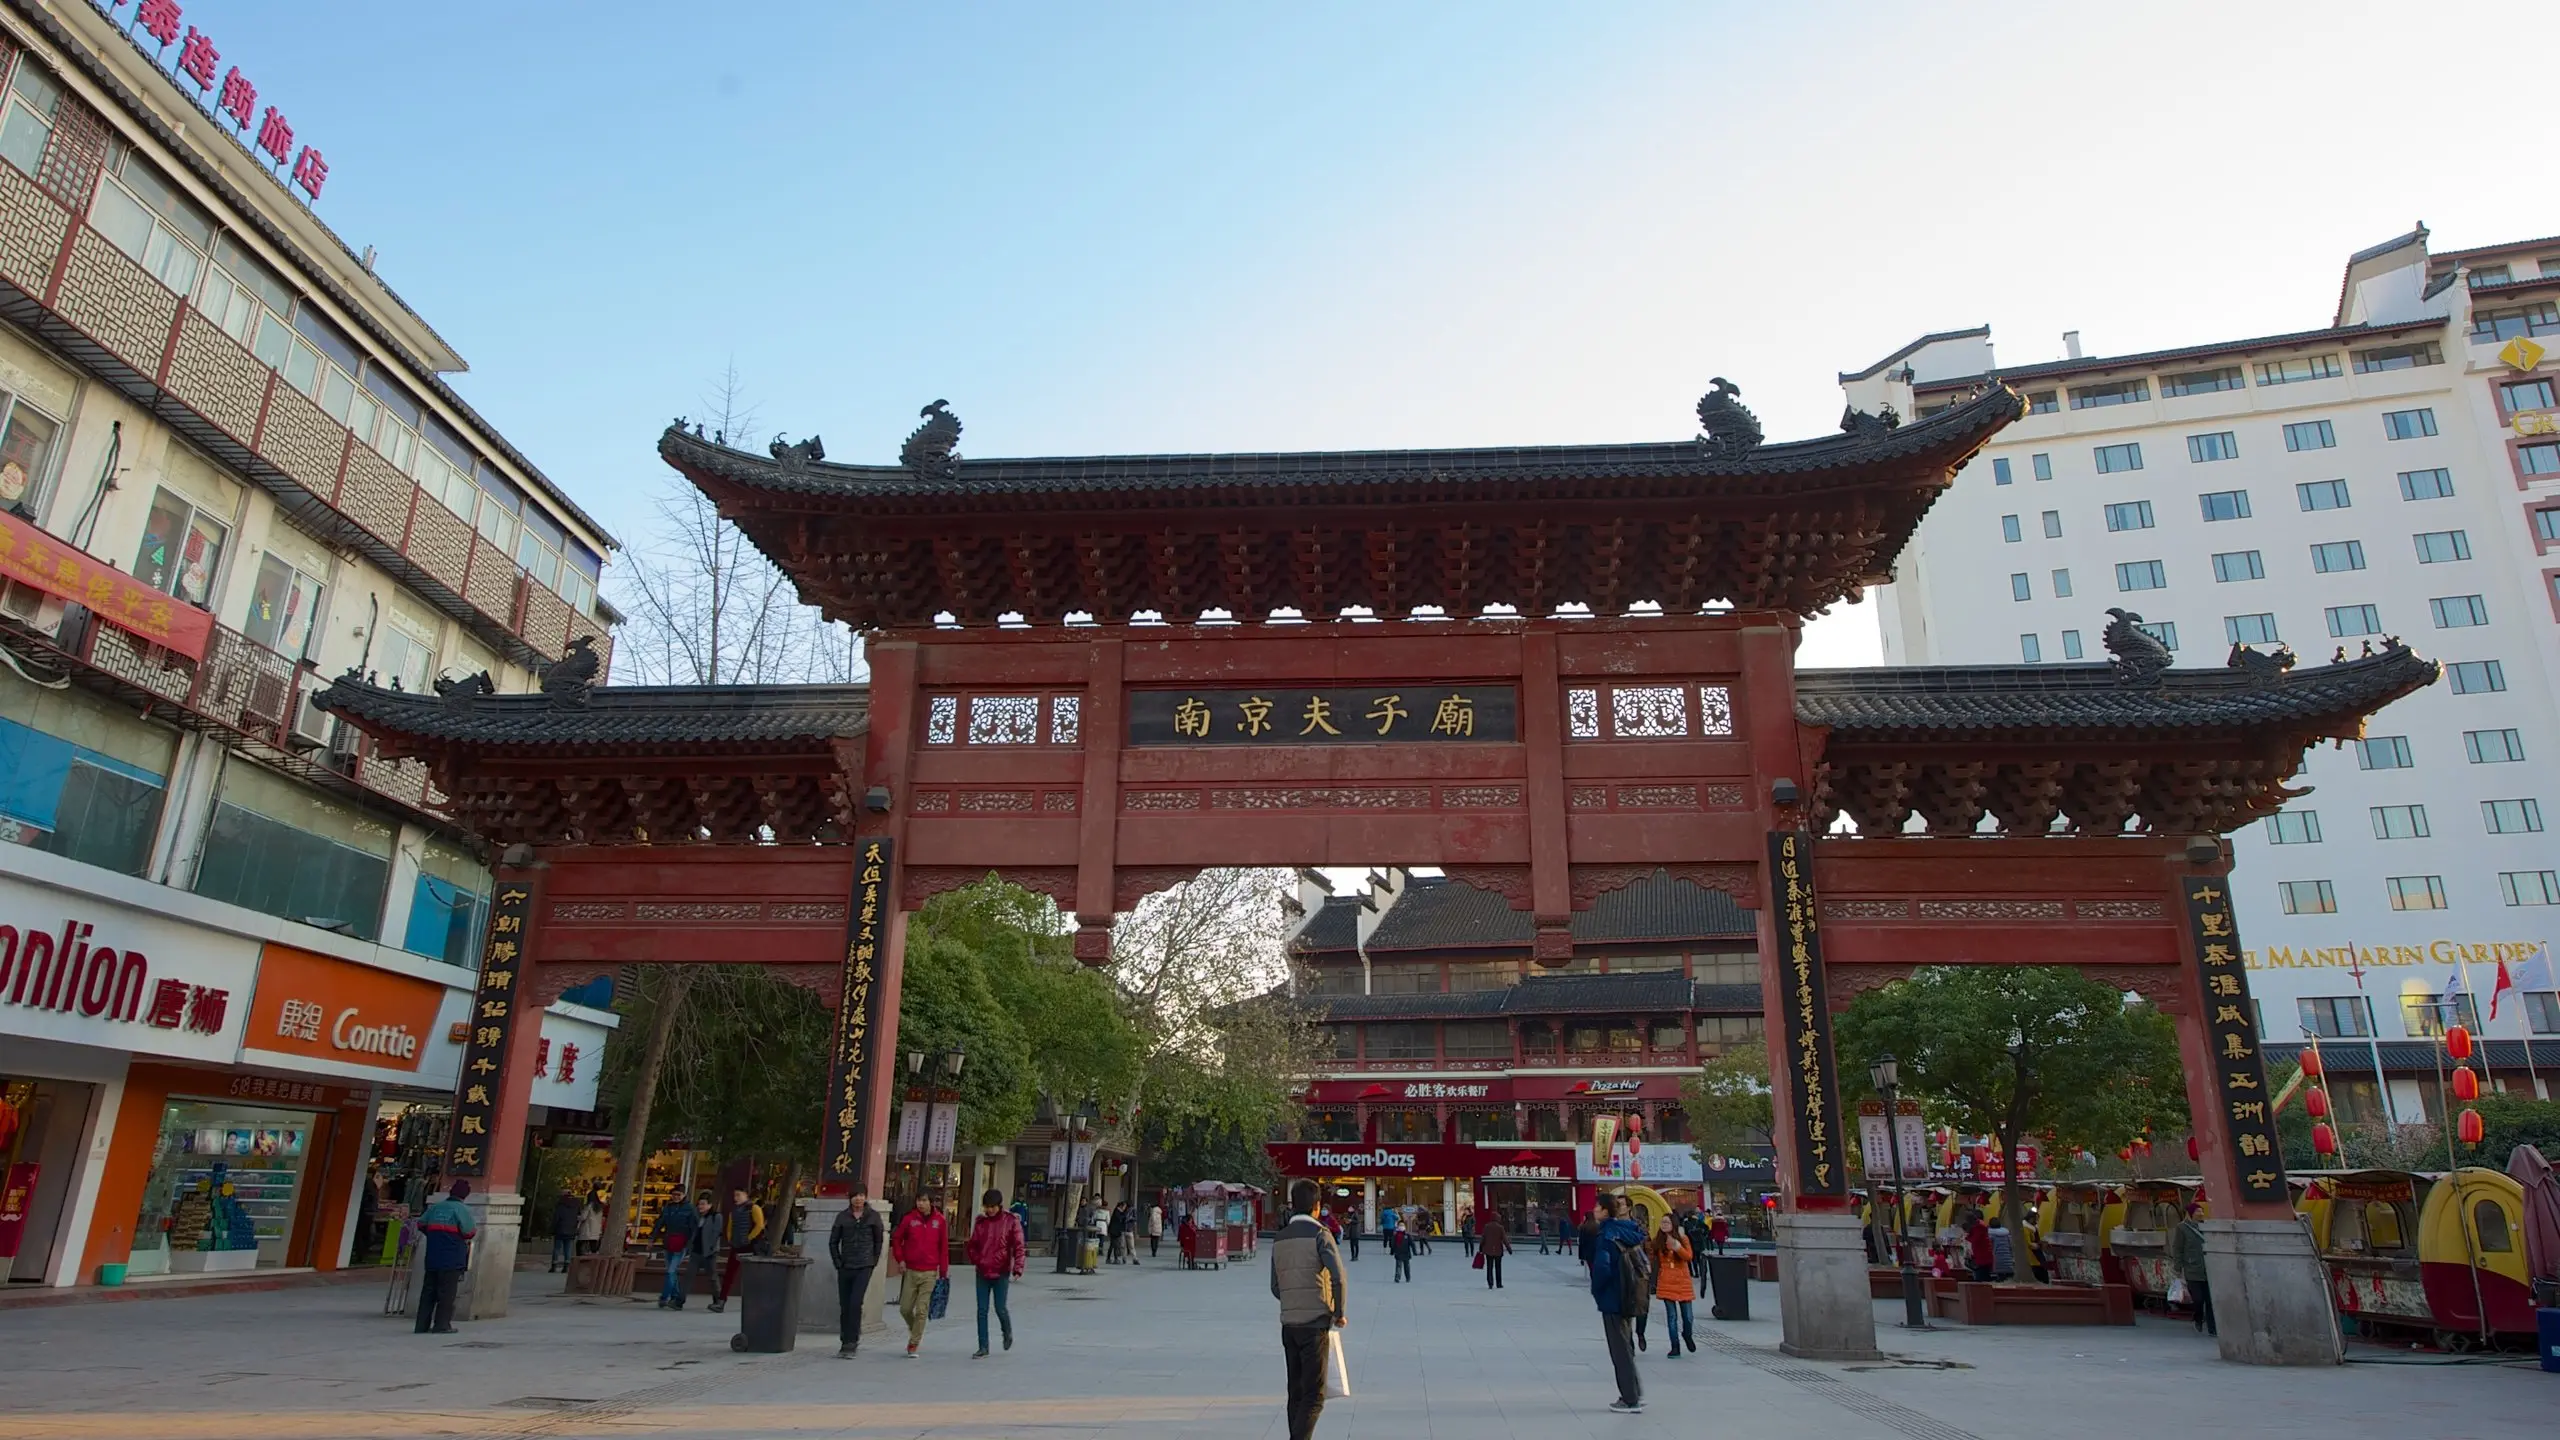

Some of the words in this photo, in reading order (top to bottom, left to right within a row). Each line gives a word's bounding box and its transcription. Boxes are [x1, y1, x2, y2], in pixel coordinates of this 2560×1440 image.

[113, 0, 329, 200] 泰连锁旅店
[1175, 694, 1473, 736] 南京夫子廟
[2267, 945, 2425, 969] MANDARIN
[143, 977, 230, 1037] 唐狮
[277, 999, 323, 1041] 康缇
[332, 1008, 416, 1060] Conttie
[1404, 1083, 1489, 1098] 必胜客欢乐餐厅
[1591, 1080, 1619, 1091] Pizza
[1620, 1080, 1644, 1090] Hut
[1489, 1165, 1560, 1178] 必胜客欢乐餐厅
